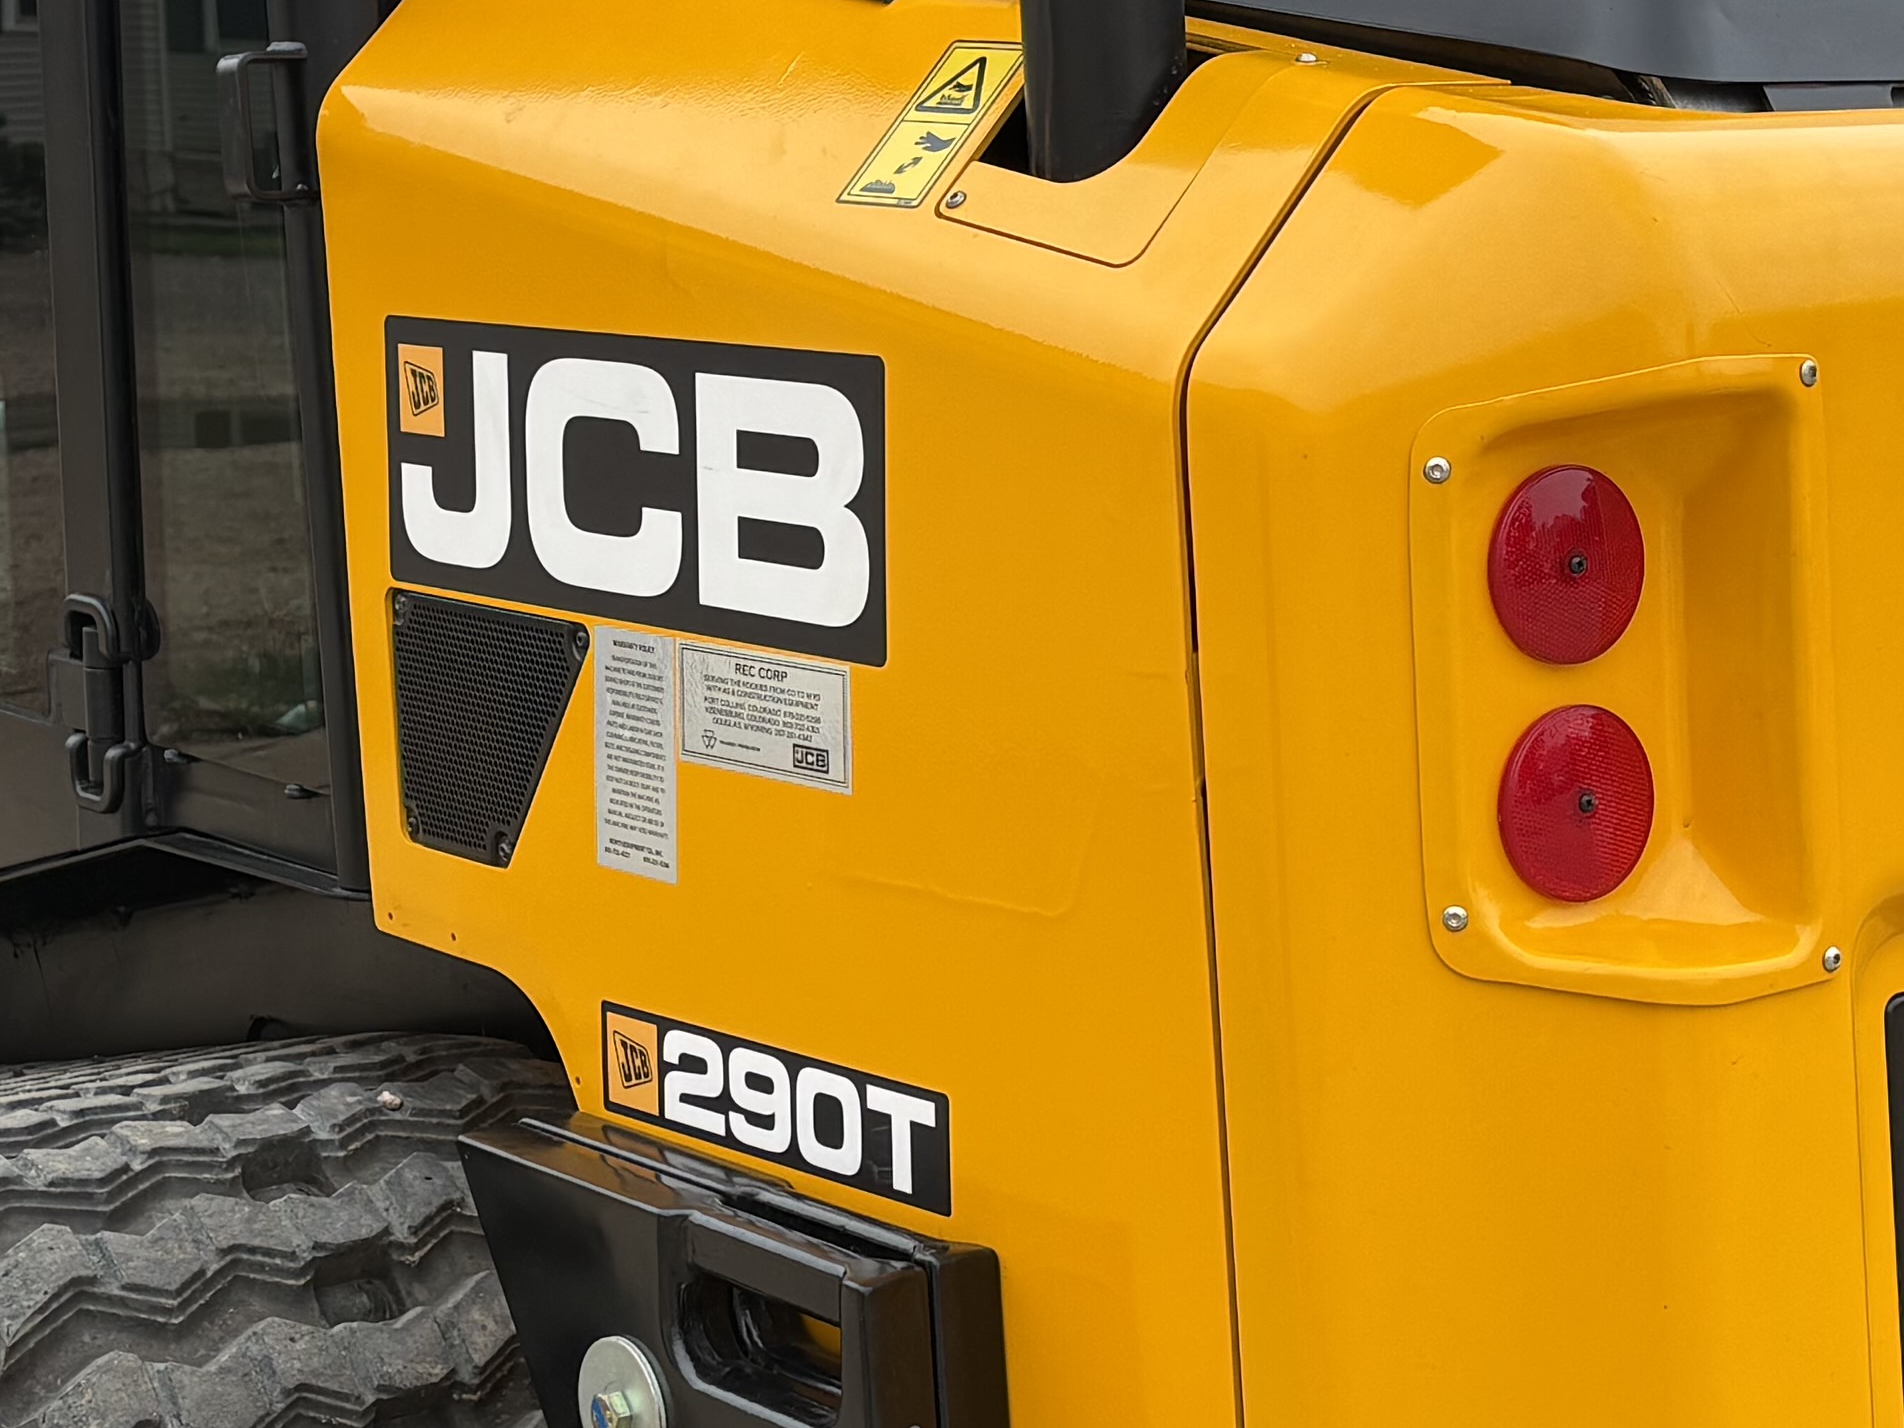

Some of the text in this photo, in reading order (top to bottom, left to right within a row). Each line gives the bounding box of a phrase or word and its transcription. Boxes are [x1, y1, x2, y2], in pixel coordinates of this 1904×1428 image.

[410, 368, 437, 410] JCB
[401, 350, 870, 627] JCB
[734, 662, 788, 683] REC CORP
[796, 750, 828, 769] JCB
[620, 1038, 650, 1083] JCB
[663, 1029, 936, 1195] 290T
